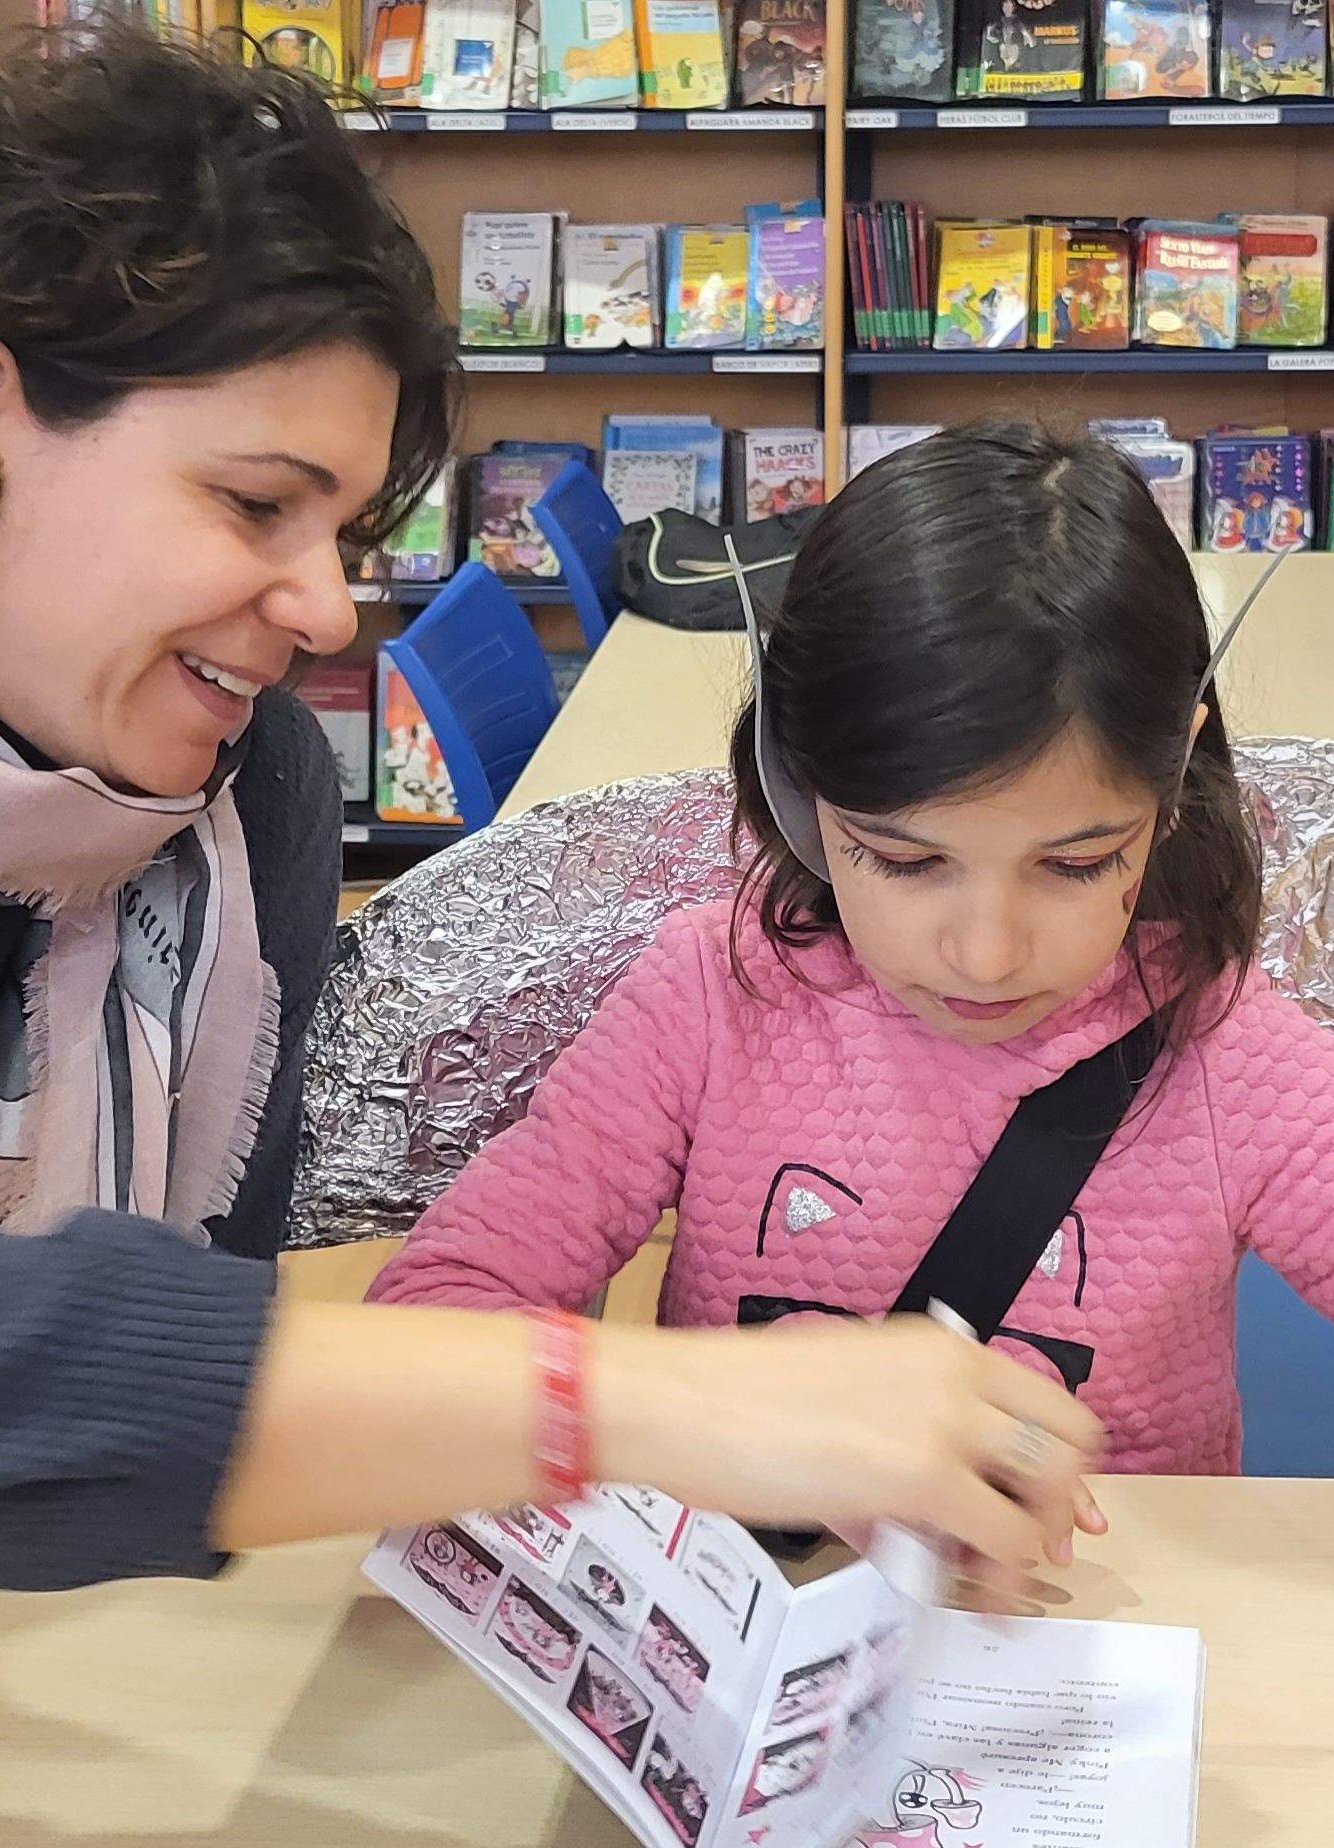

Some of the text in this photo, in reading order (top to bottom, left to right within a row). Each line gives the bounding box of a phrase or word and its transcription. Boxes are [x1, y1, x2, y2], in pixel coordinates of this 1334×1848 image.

[753, 443, 815, 459] THE CRAZY
[755, 457, 815, 474] HAACKS
